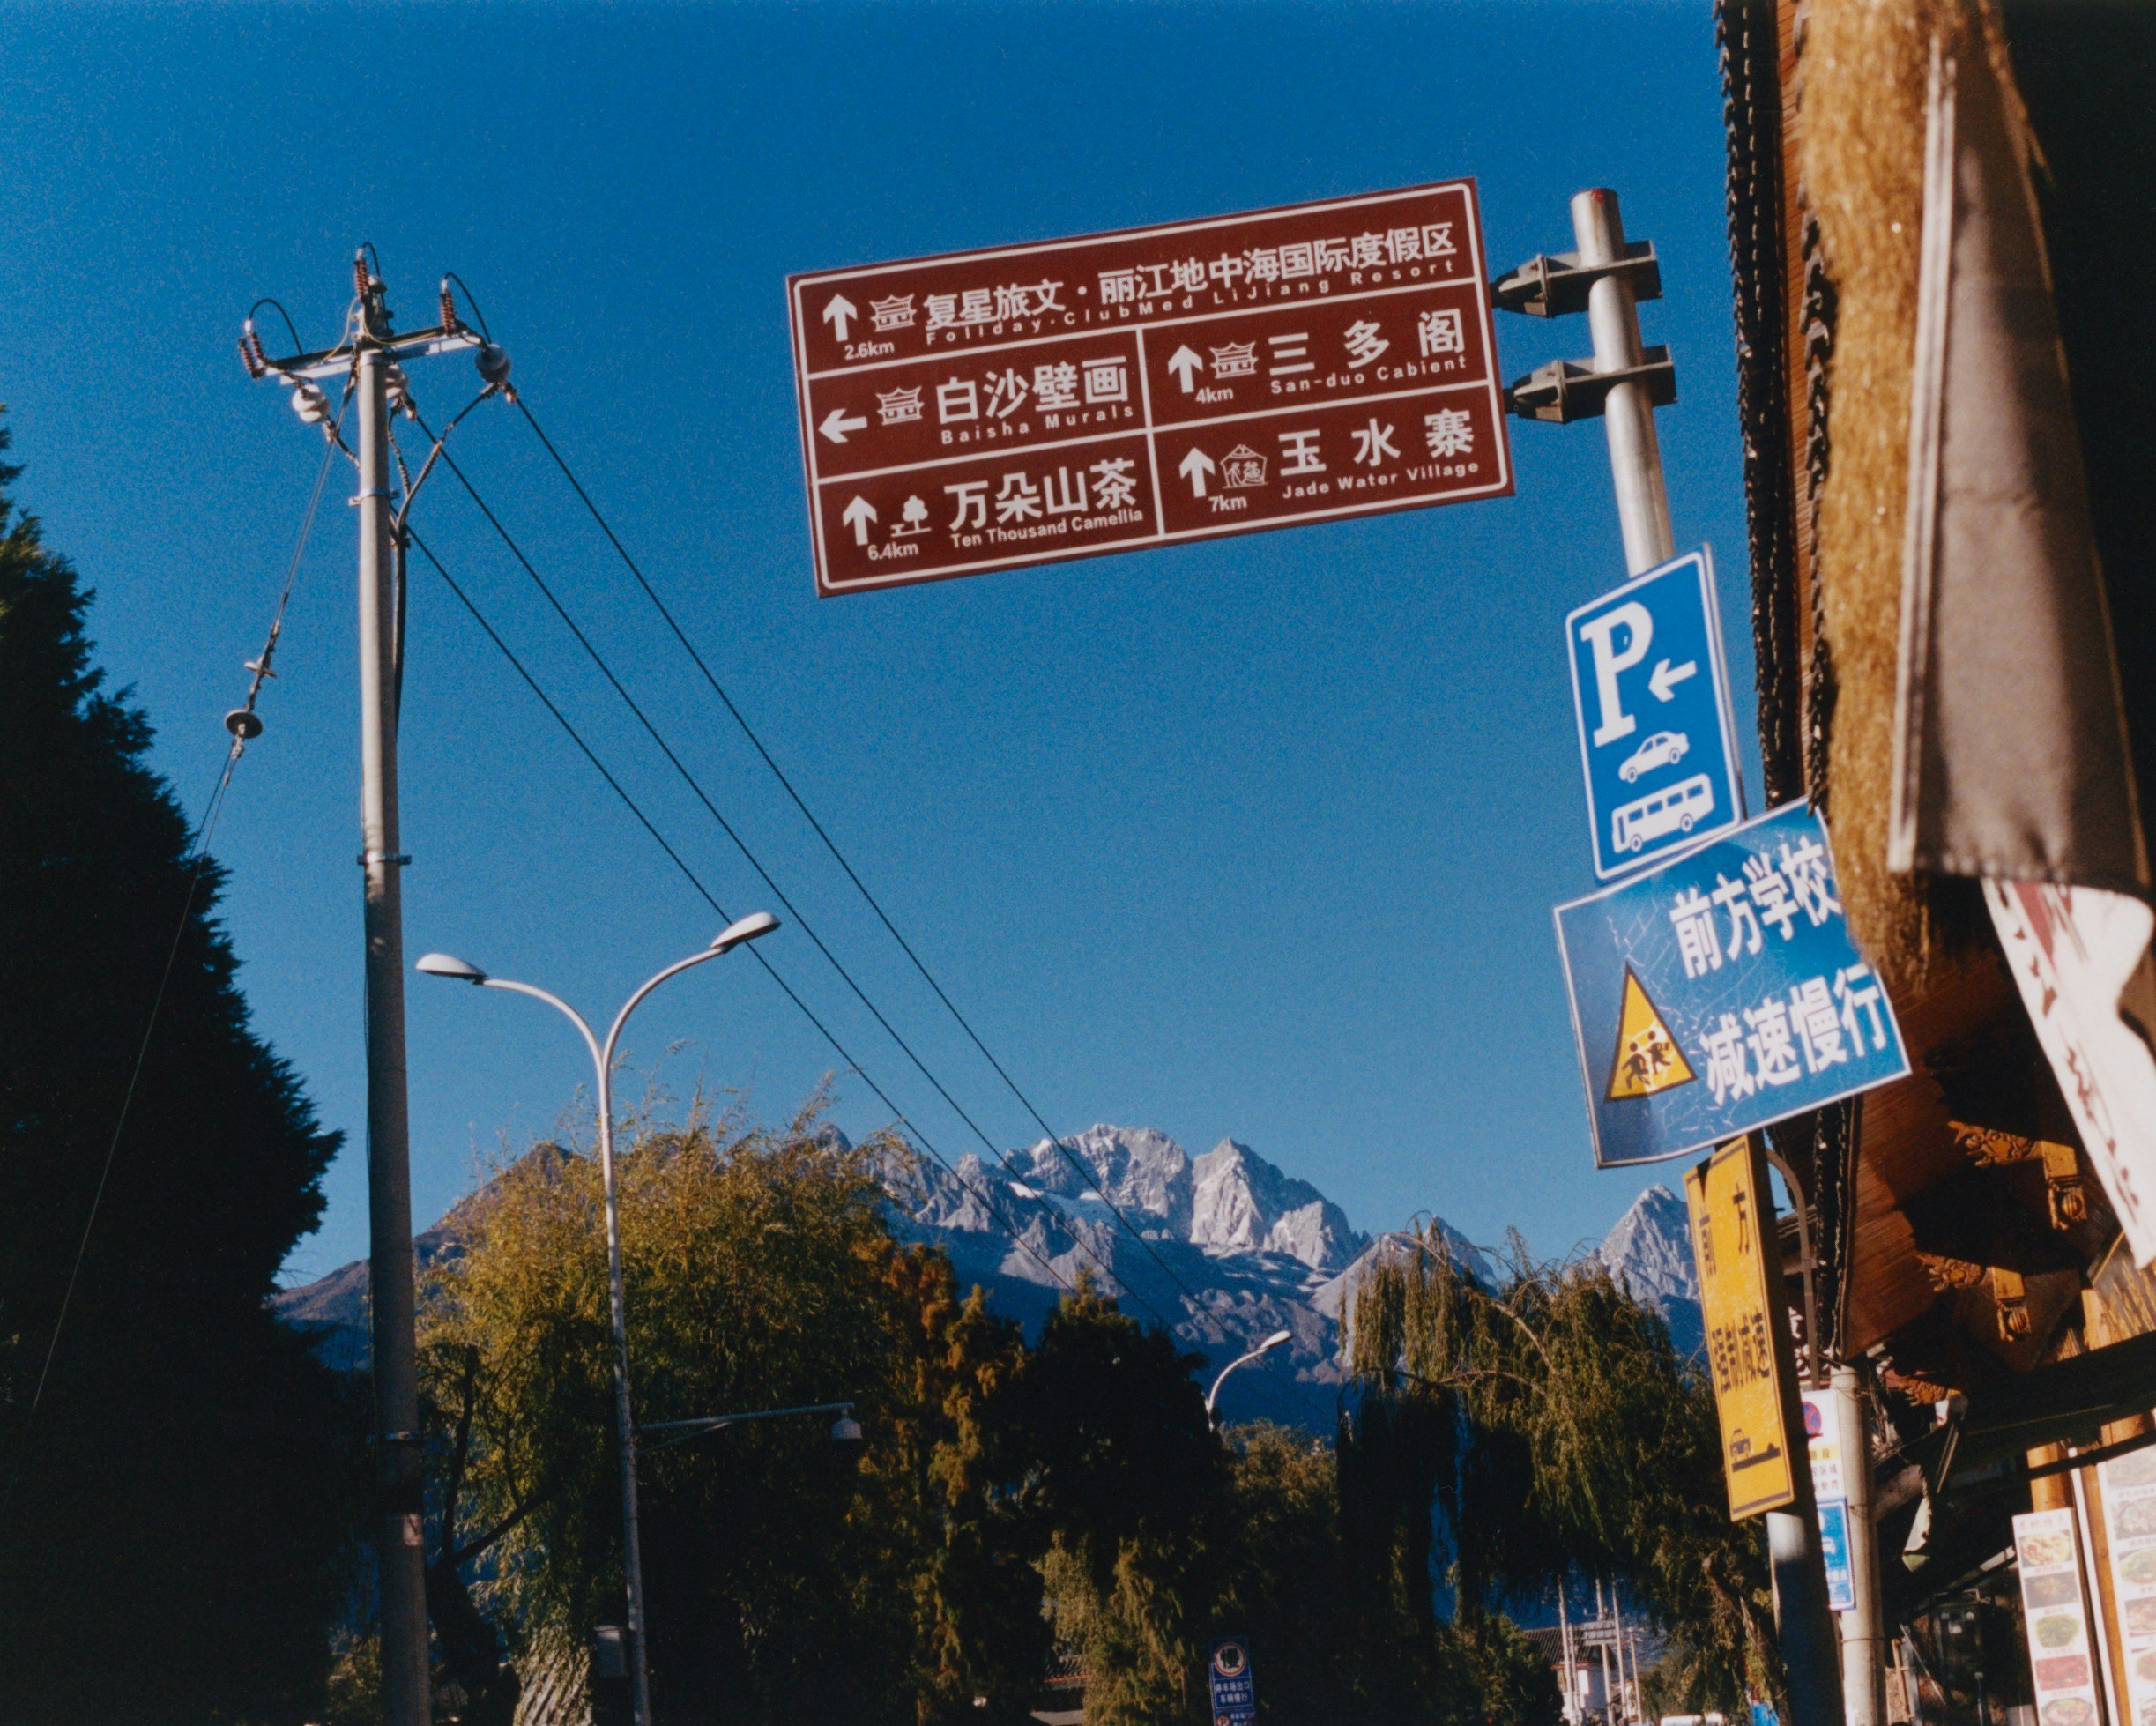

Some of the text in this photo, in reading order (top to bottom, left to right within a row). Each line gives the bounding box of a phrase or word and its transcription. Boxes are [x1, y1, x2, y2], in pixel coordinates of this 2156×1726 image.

[1215, 279, 1329, 304] LiJiang
[1351, 258, 1455, 286] Resort
[844, 339, 895, 361] 2.6km
[1268, 308, 1465, 376] 三多阁
[935, 355, 1129, 424] 白沙壁画
[1195, 386, 1234, 404] 4km
[1270, 355, 1467, 394] San-duo Cabient
[940, 404, 1134, 445] Baisha Murals
[1278, 407, 1475, 477] 玉水寨
[944, 457, 1138, 531] 万朵山茶
[1282, 459, 1480, 500] Jade Water Village
[1208, 495, 1248, 512] 7km
[867, 540, 919, 562] 6.4km
[951, 508, 1144, 550] Ten Thousand Camellia
[1580, 601, 1654, 748] P
[1670, 834, 1842, 979] 前方学校
[1699, 963, 1888, 1107] 减速慢行
